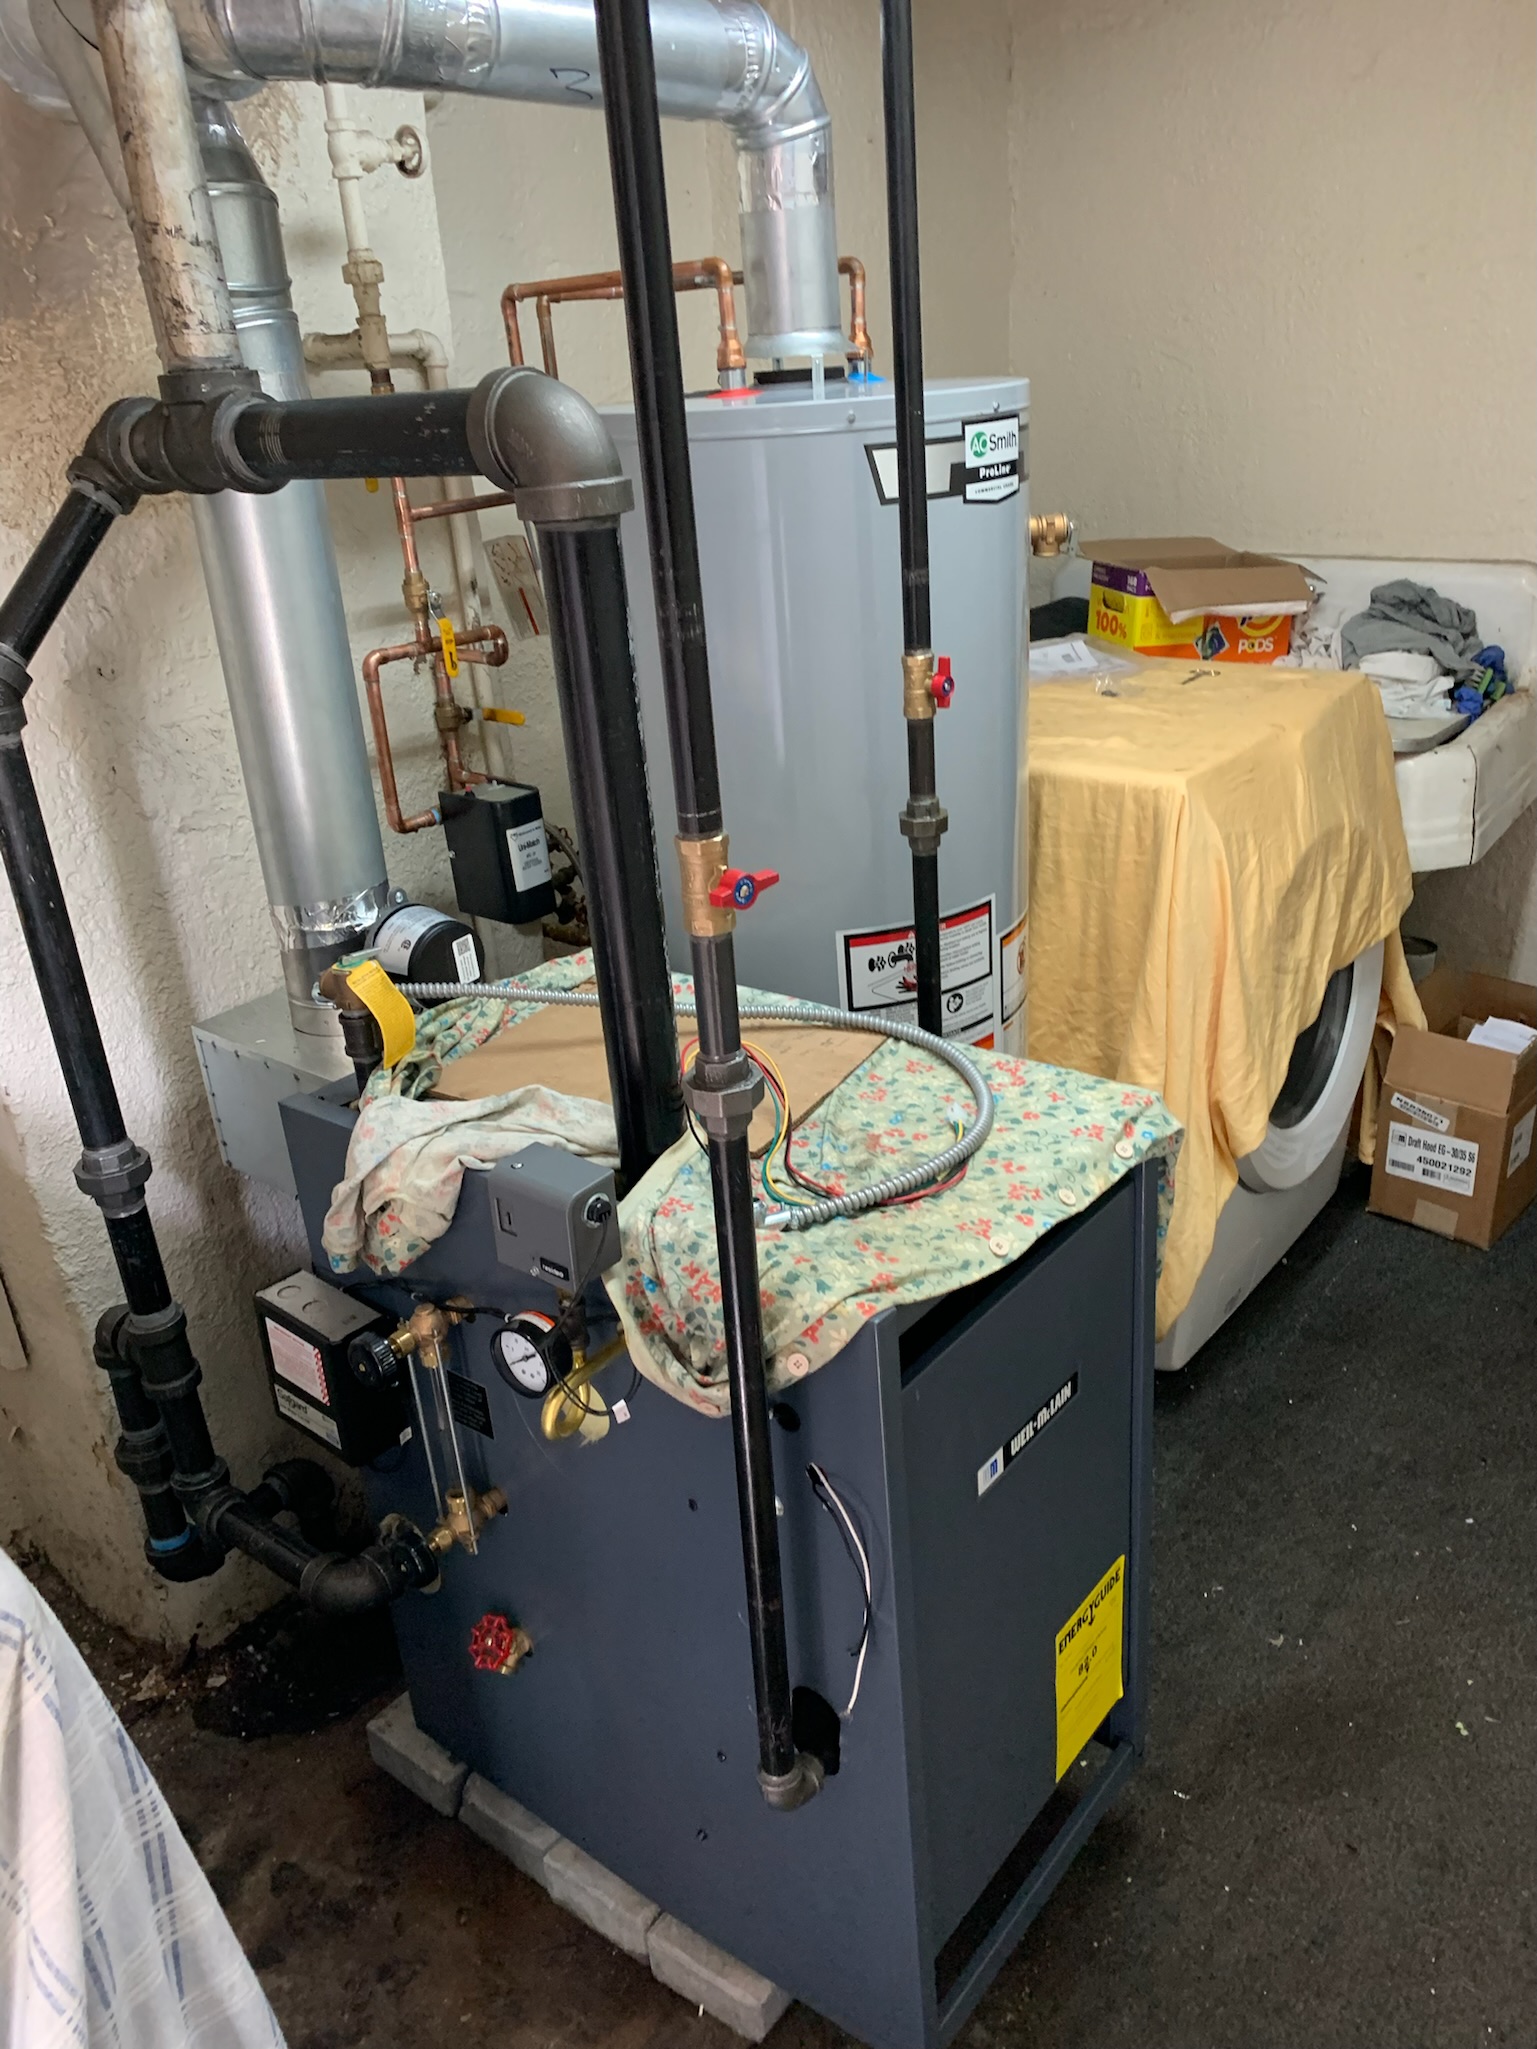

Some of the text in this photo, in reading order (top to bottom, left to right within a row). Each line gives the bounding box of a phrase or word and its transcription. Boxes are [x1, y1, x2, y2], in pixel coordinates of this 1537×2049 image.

[989, 431, 1017, 452] Smith
[1095, 609, 1127, 640] 100%
[1238, 637, 1274, 655] PODS
[1408, 1136, 1422, 1149] Draft
[1422, 1140, 1437, 1153] Hood
[1416, 1155, 1472, 1177] 450021292
[1058, 1567, 1121, 1655] ENERGYGUIDE
